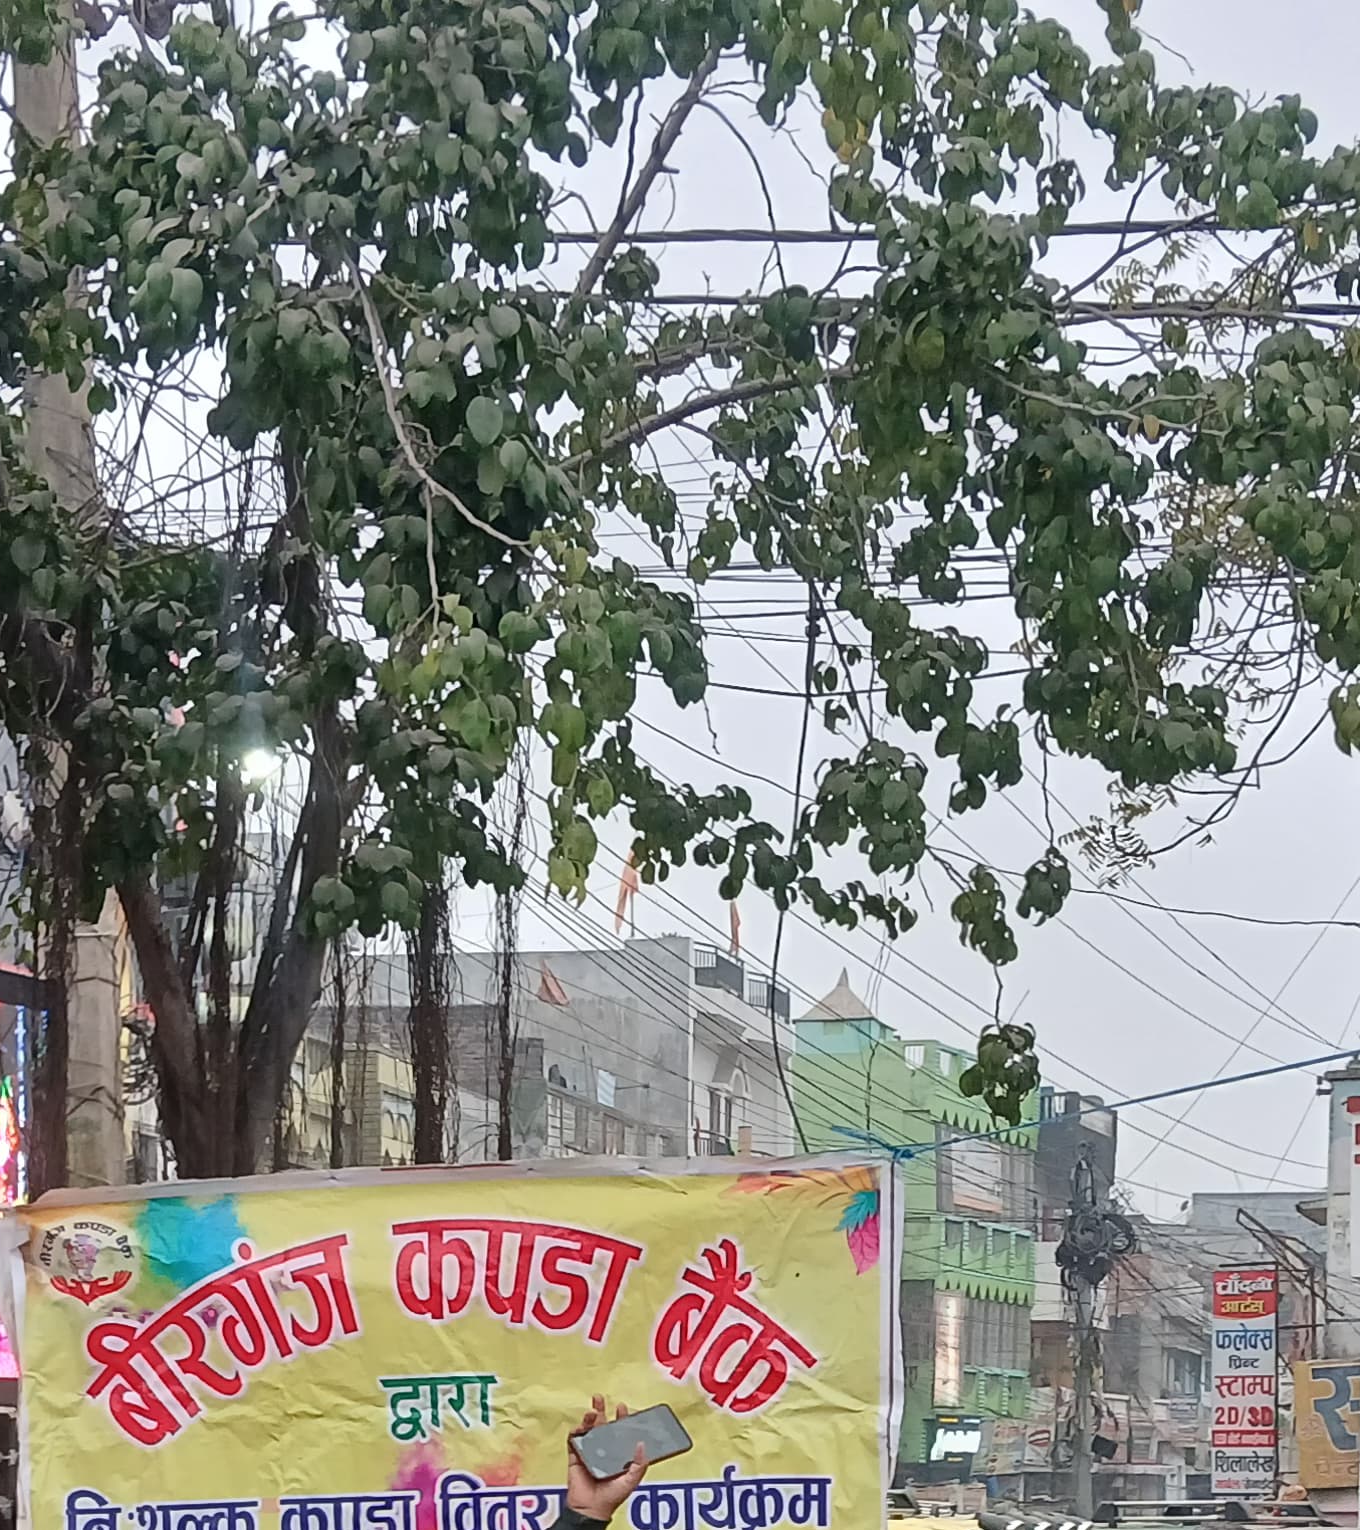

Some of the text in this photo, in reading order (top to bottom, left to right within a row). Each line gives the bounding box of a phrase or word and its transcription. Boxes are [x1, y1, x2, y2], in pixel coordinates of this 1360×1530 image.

[86, 1218, 818, 1446] बीरगंज कपडा बैंक
[379, 1375, 498, 1440] द्वारा
[1214, 1405, 1274, 1428] 2D/3D
[1214, 1450, 1275, 1473] शिलालेख
